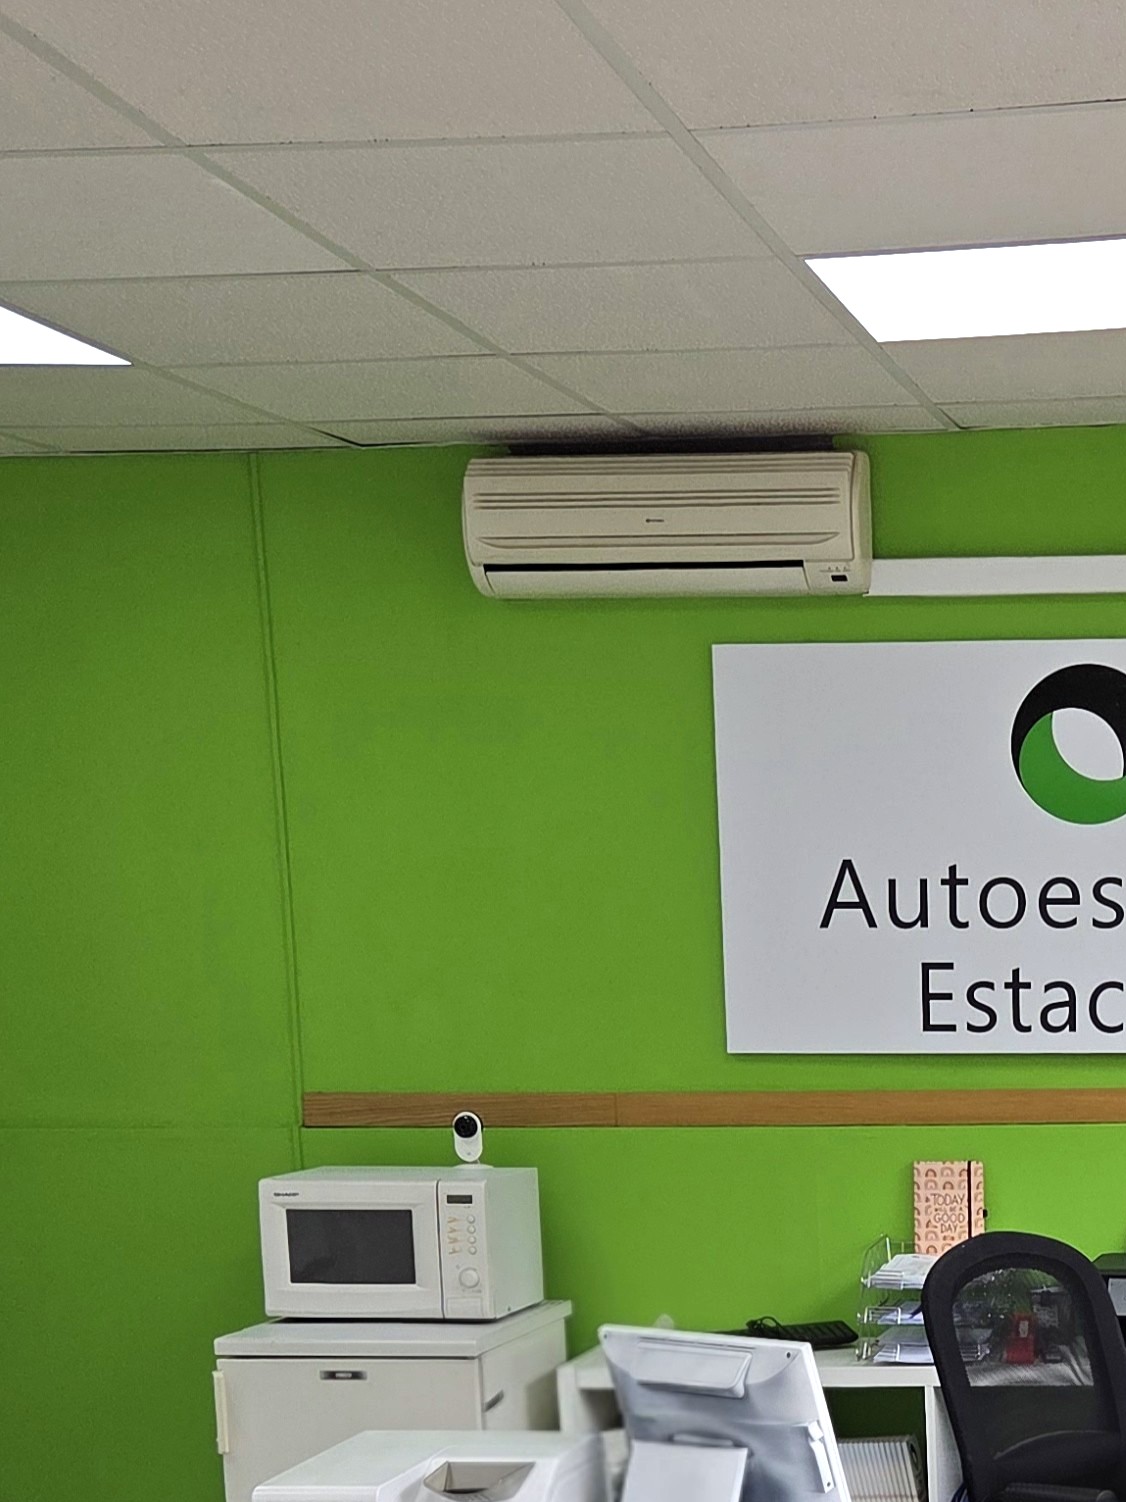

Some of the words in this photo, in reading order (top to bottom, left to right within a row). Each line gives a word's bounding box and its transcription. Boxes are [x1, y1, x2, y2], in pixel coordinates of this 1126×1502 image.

[930, 1193, 965, 1206] TODAY
[933, 1213, 965, 1223] GOOD
[940, 1223, 958, 1233] DAY
